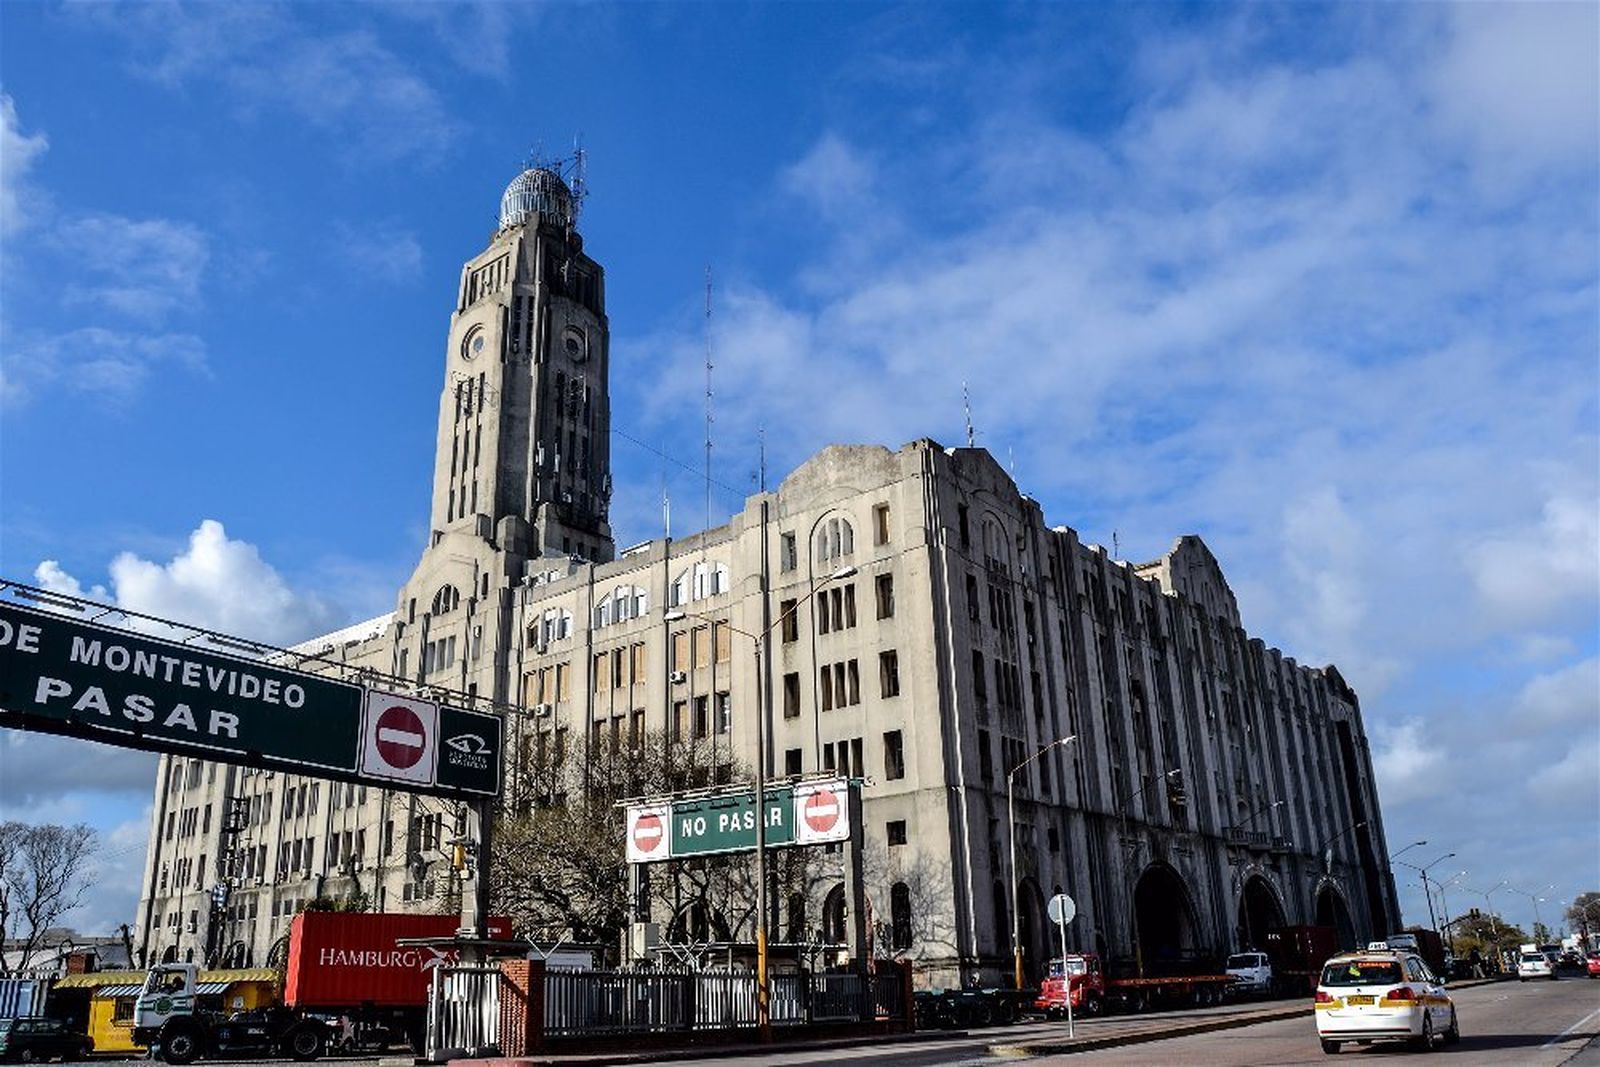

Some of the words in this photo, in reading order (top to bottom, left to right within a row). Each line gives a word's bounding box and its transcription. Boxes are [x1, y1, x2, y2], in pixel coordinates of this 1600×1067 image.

[70, 636, 305, 708] MONTEVIDEO
[34, 676, 240, 738] PASAR
[682, 816, 706, 837] NO
[320, 948, 416, 967] HAMBURG
